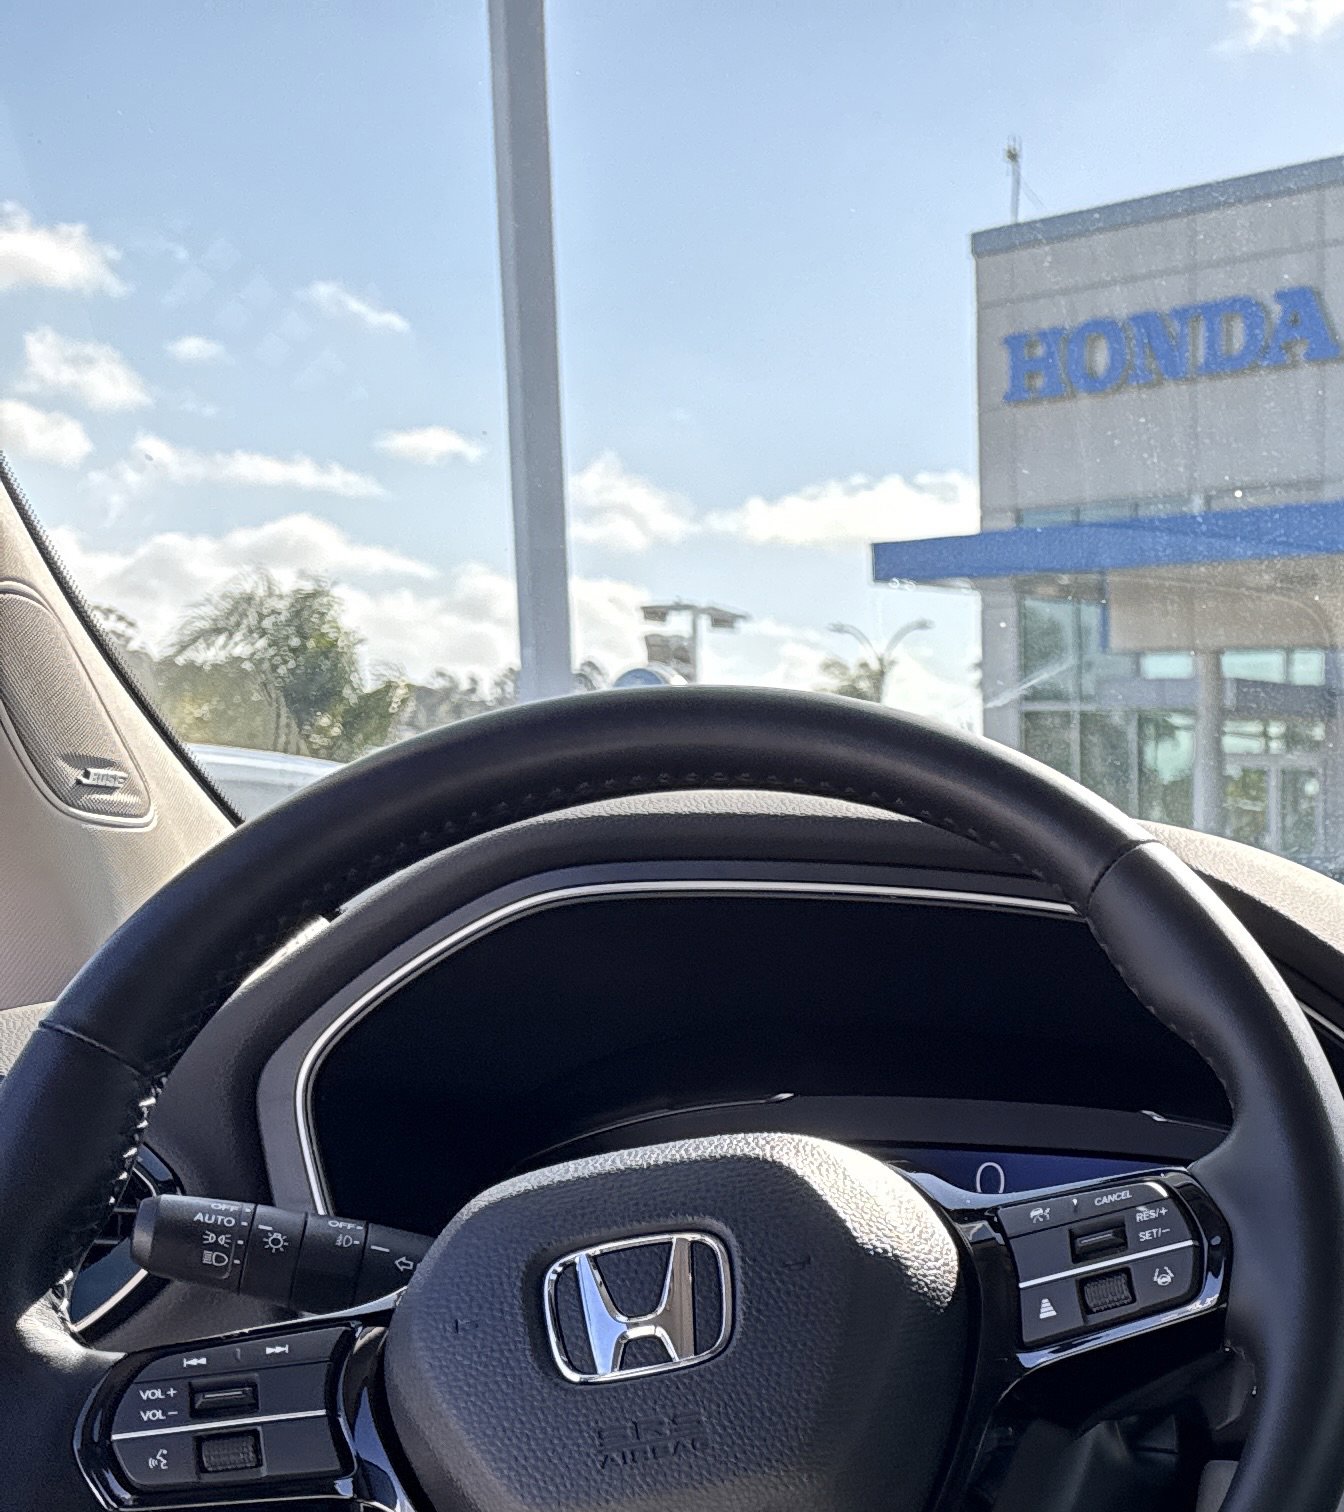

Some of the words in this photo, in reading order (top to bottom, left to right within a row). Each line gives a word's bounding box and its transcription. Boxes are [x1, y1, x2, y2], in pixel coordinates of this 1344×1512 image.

[1003, 285, 1342, 405] HONDA
[975, 1161, 1006, 1194] 0
[1094, 1189, 1133, 1207] CANCEL
[210, 1203, 241, 1213] OFF
[1135, 1207, 1169, 1223] RES/+
[193, 1212, 236, 1227] AUTO
[327, 1219, 357, 1230] OFF
